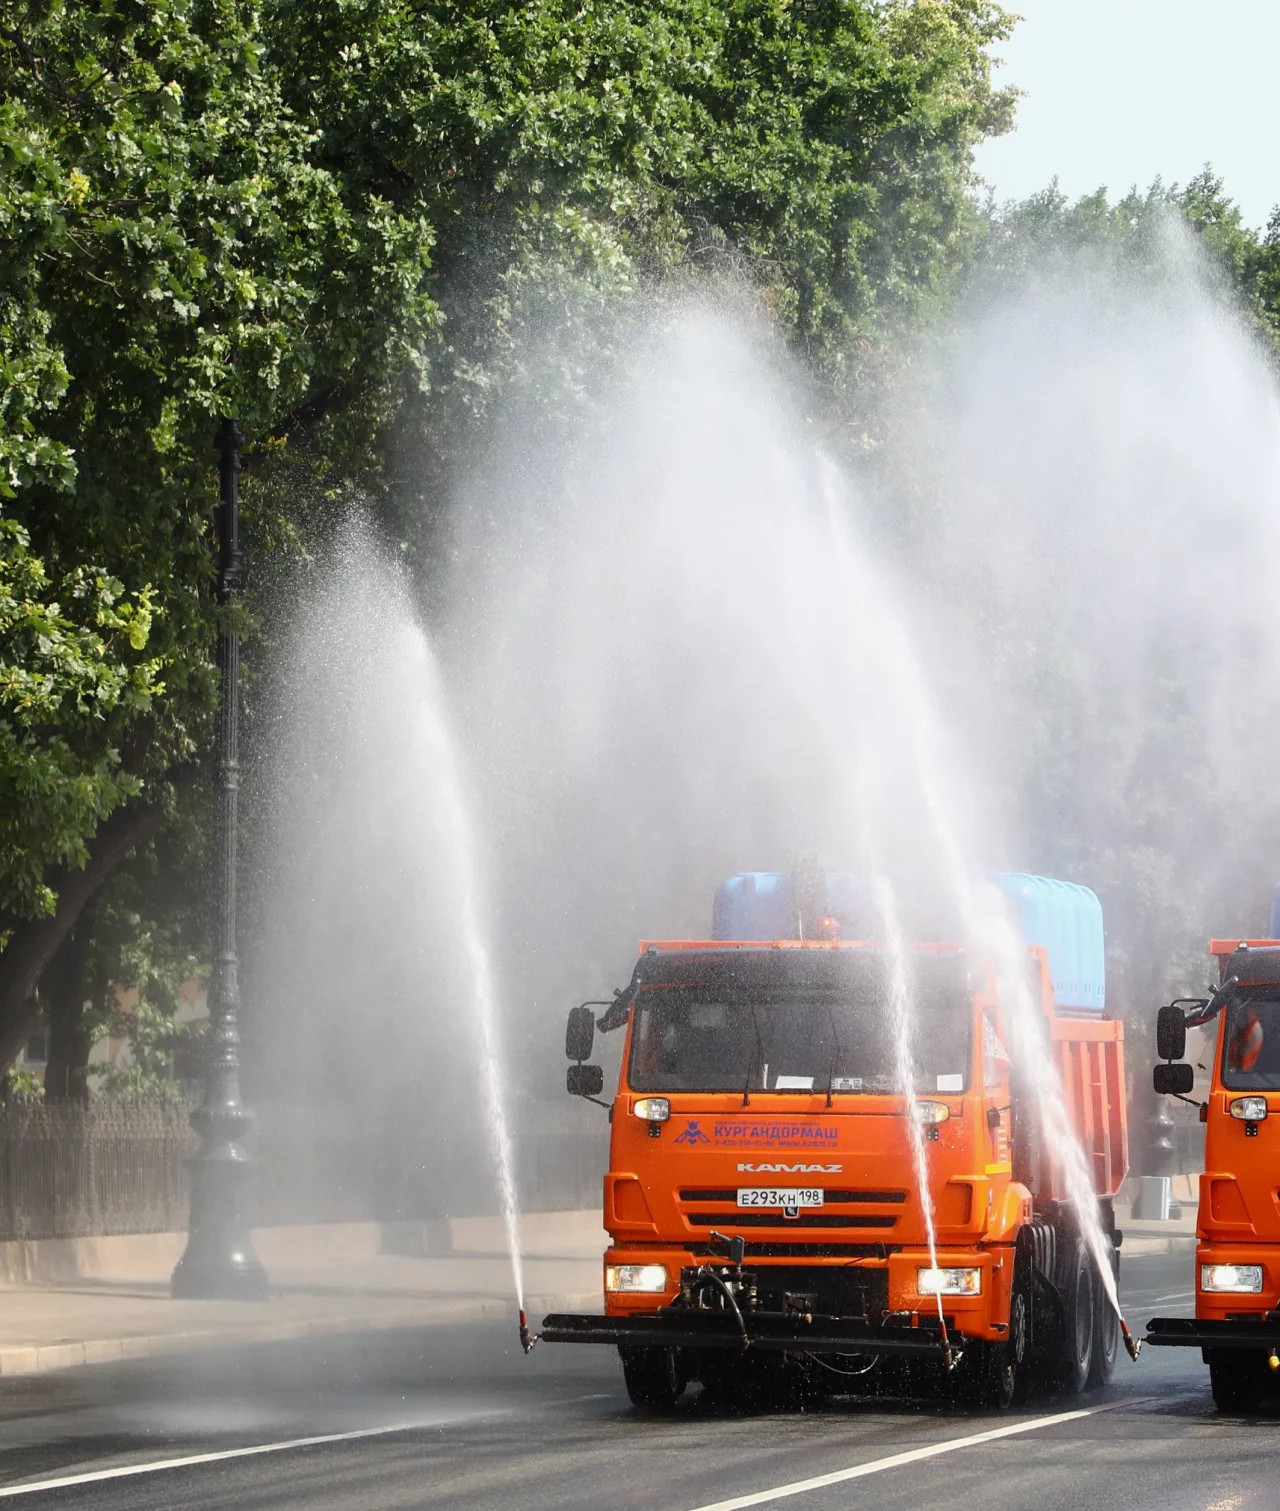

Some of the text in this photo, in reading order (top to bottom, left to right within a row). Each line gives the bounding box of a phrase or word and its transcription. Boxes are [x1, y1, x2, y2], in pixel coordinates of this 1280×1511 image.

[714, 1127, 838, 1139] КУРГАНДОРМАШ
[737, 1163, 843, 1173] KAMAZ
[798, 1190, 820, 1201] 198
